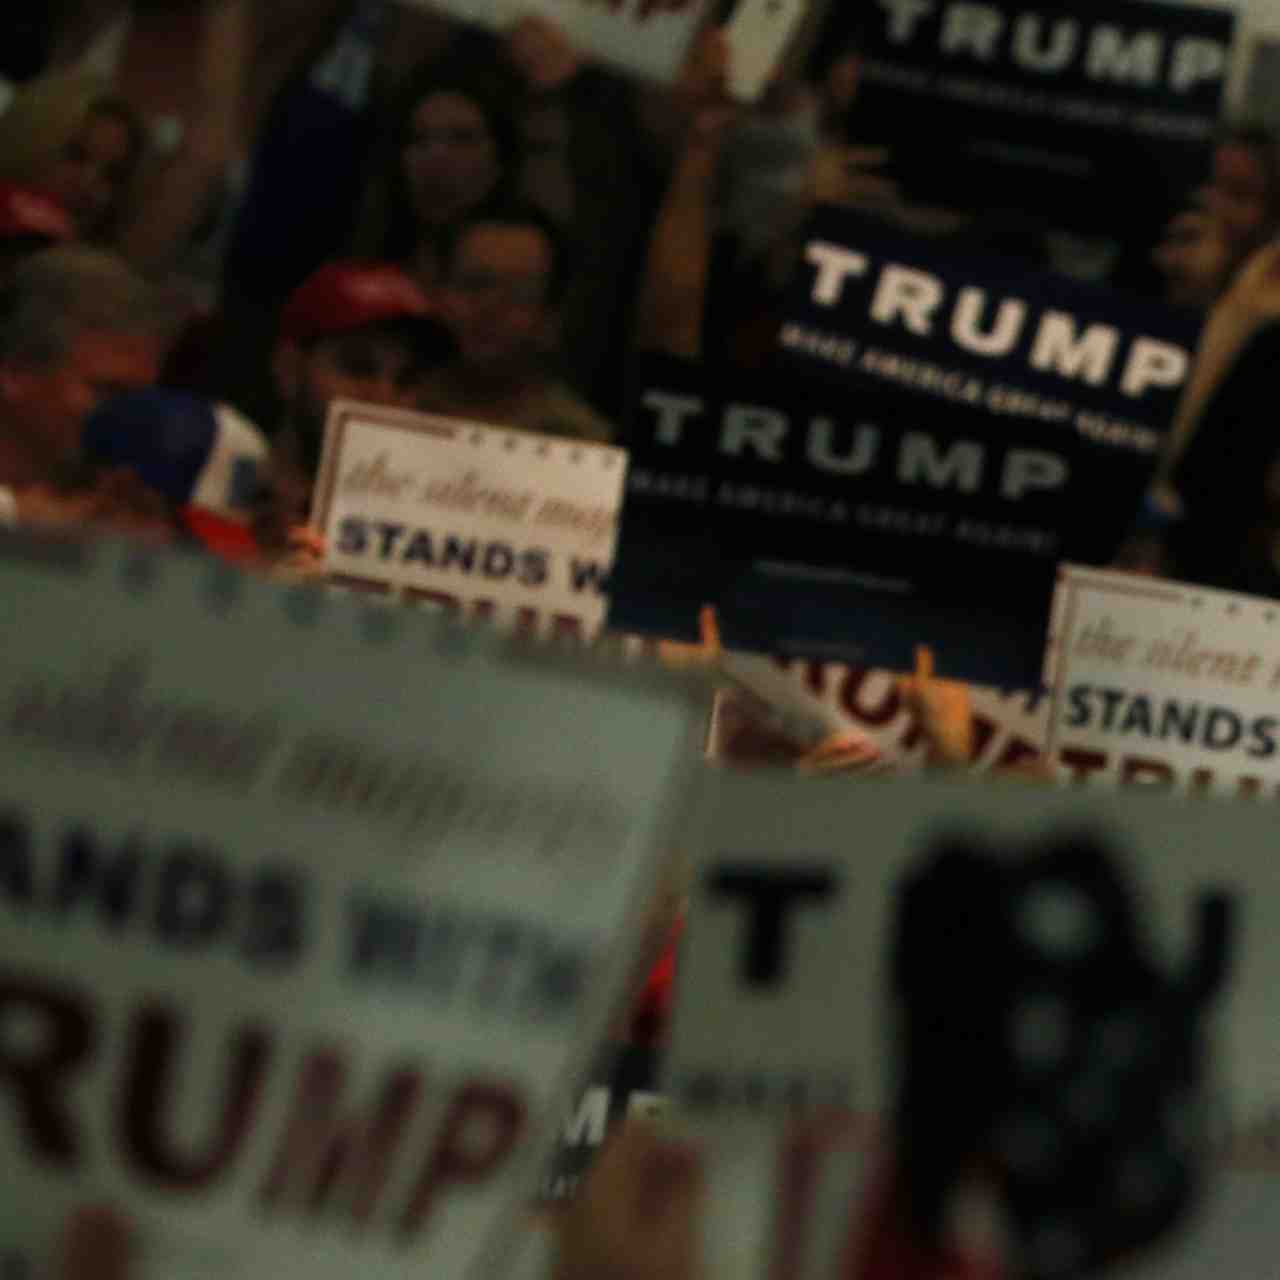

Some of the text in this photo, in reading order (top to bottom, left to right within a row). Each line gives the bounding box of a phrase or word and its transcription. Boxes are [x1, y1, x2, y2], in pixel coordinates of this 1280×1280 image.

[884, 0, 1226, 95] TRUMP
[802, 239, 1190, 400] TRUMP
[640, 388, 1070, 502] TRUMP
[337, 514, 548, 587] STANDS
[1068, 683, 1280, 760] STANDS
